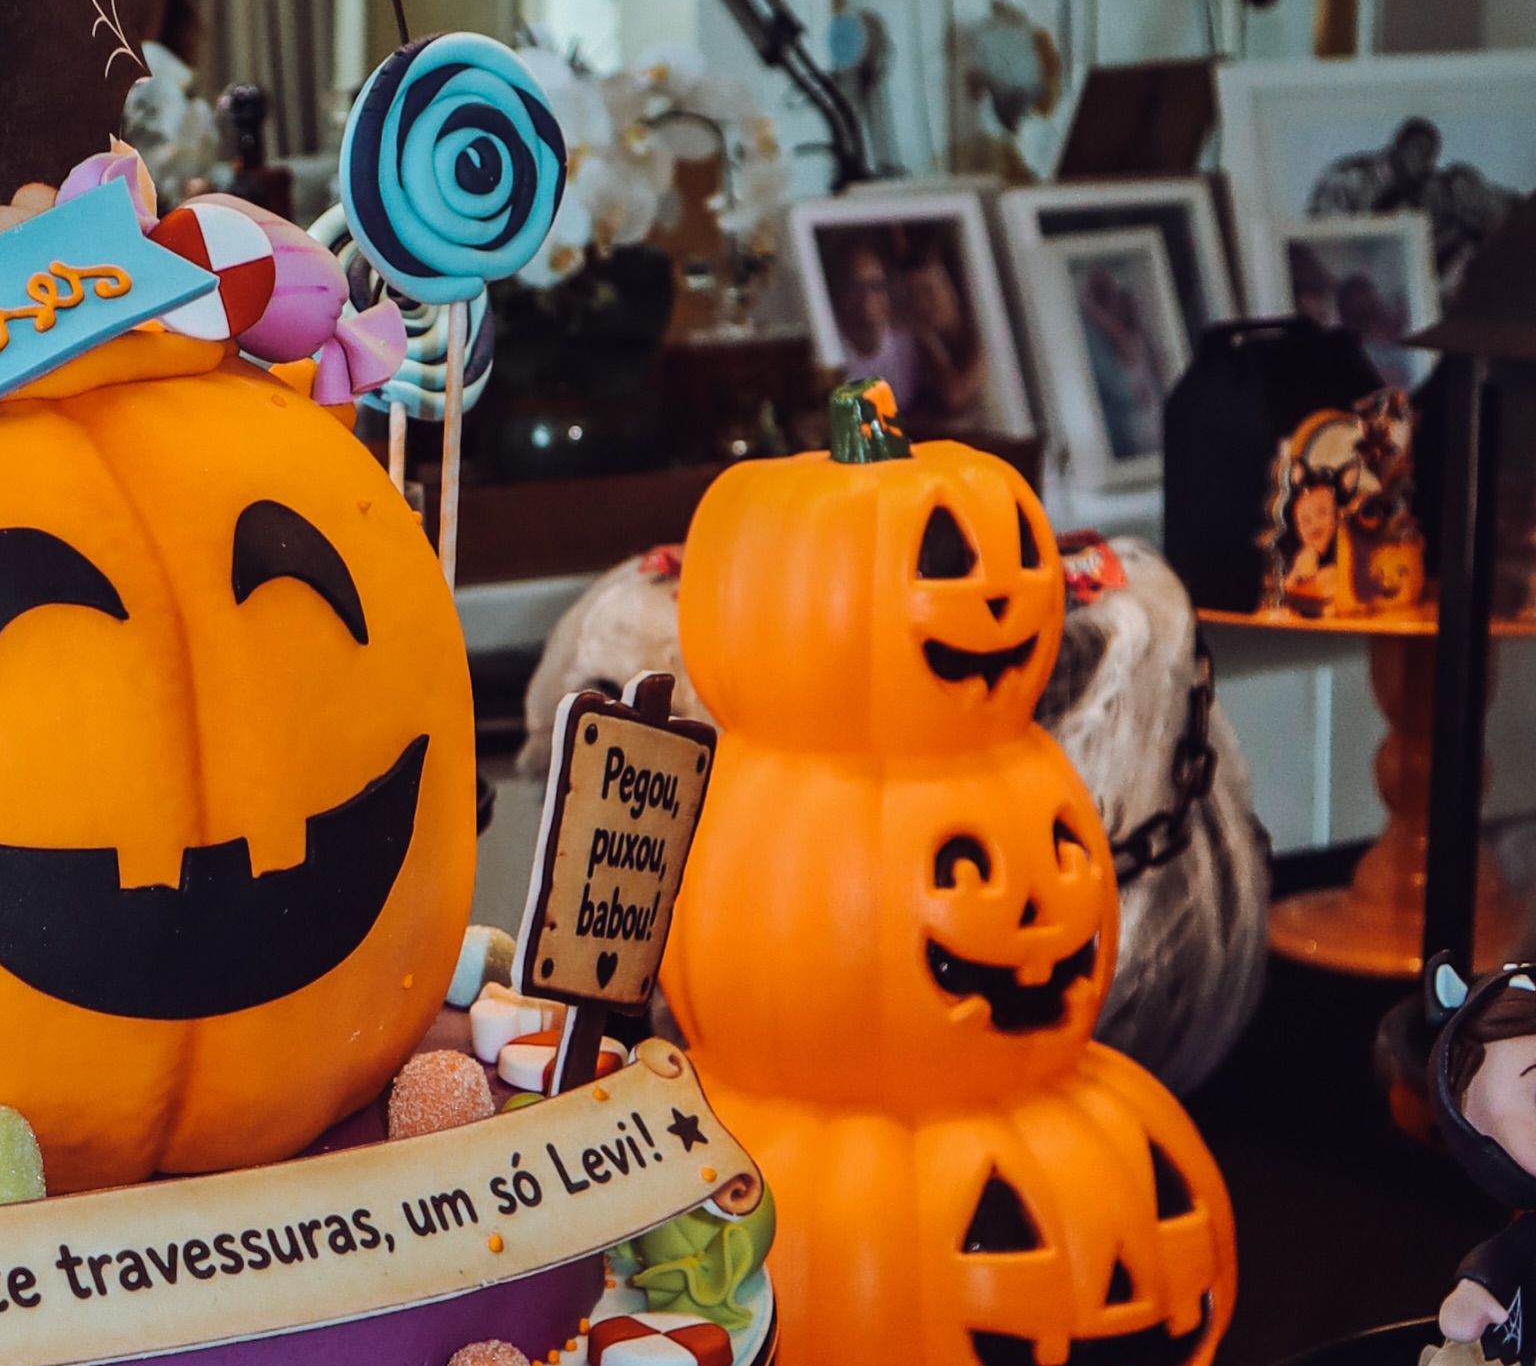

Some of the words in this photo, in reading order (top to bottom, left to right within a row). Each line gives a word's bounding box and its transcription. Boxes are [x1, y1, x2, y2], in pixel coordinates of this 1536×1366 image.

[601, 746, 681, 821] Pegou,
[587, 826, 668, 883] puxou,
[575, 882, 662, 942] babou!
[55, 1208, 396, 1300] travessuras,
[402, 1188, 479, 1237] um
[490, 1150, 543, 1216] só
[545, 1111, 664, 1196] Levi!
